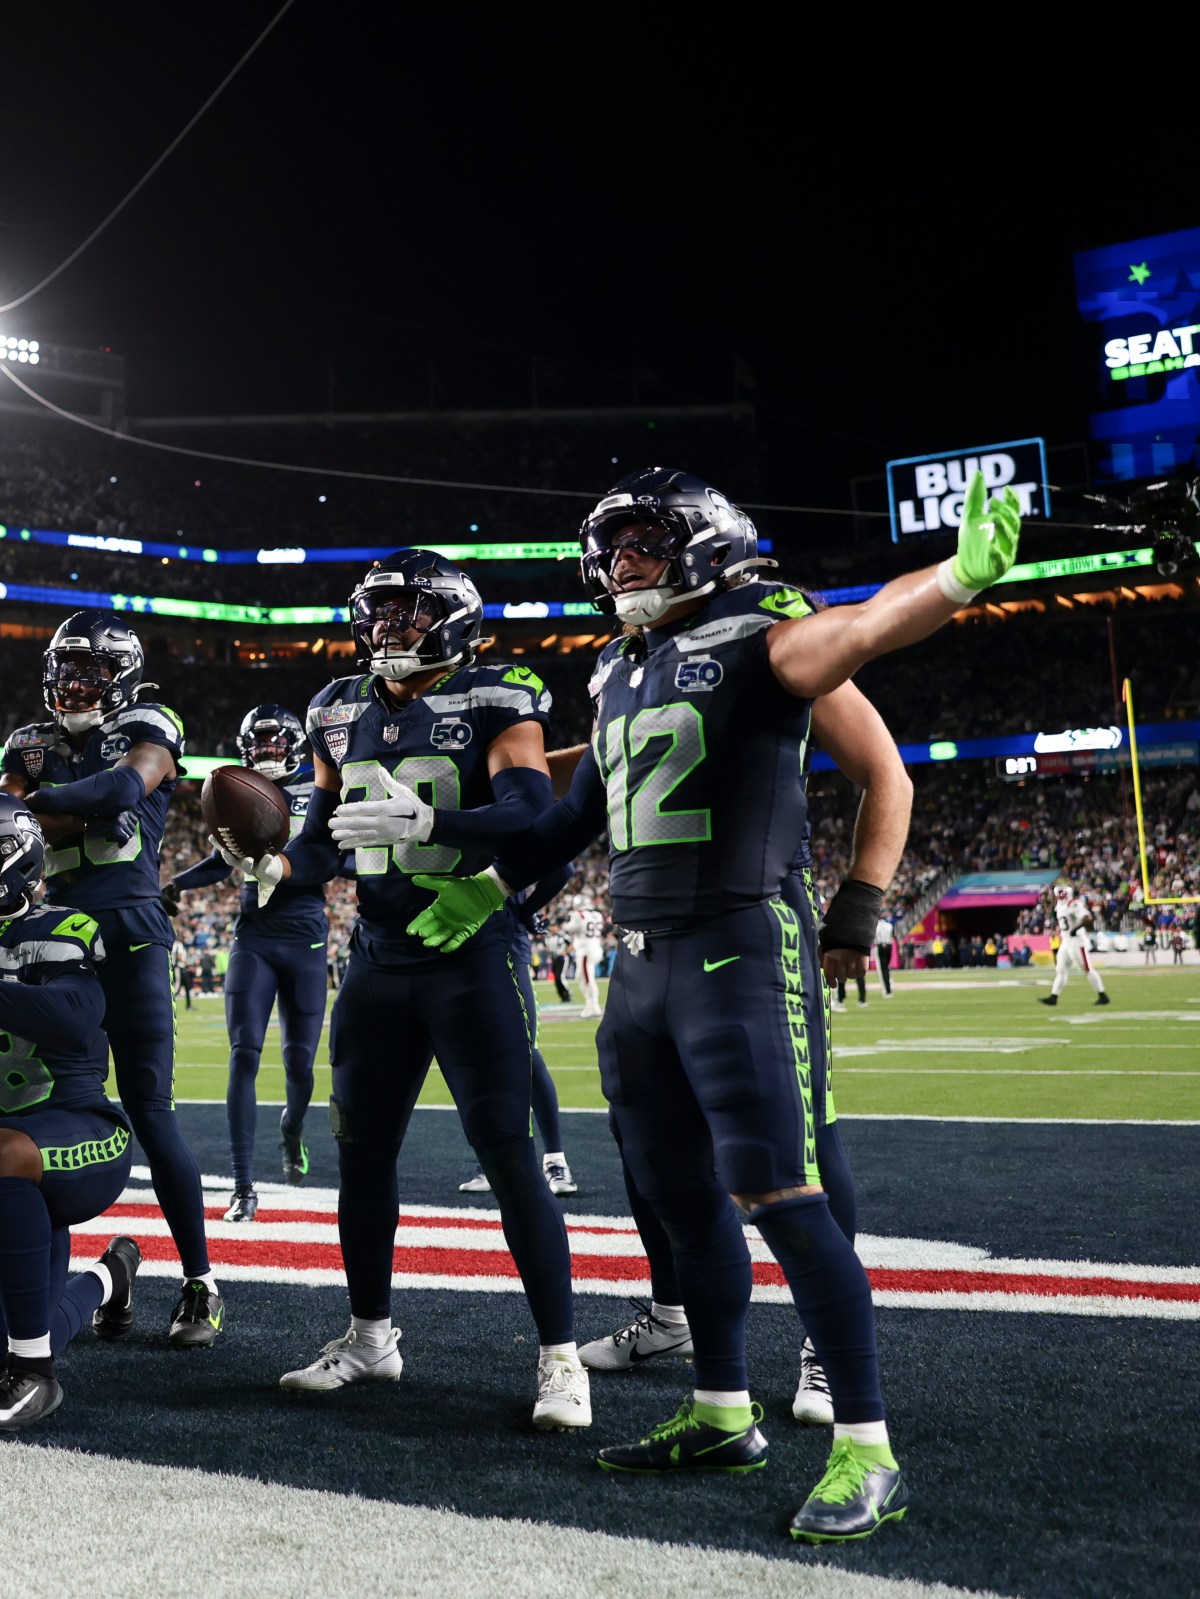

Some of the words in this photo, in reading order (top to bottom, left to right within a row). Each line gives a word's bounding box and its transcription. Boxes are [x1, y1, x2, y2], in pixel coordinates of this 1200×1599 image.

[1104, 324, 1200, 370] SEAT
[915, 452, 1016, 499] BUD
[1101, 553, 1136, 566] LX
[689, 626, 733, 641] SEAHAWKS
[676, 661, 722, 688] 50
[326, 732, 346, 742] USA
[431, 723, 471, 746] 50
[23, 752, 42, 761] USA
[329, 745, 346, 755] 250
